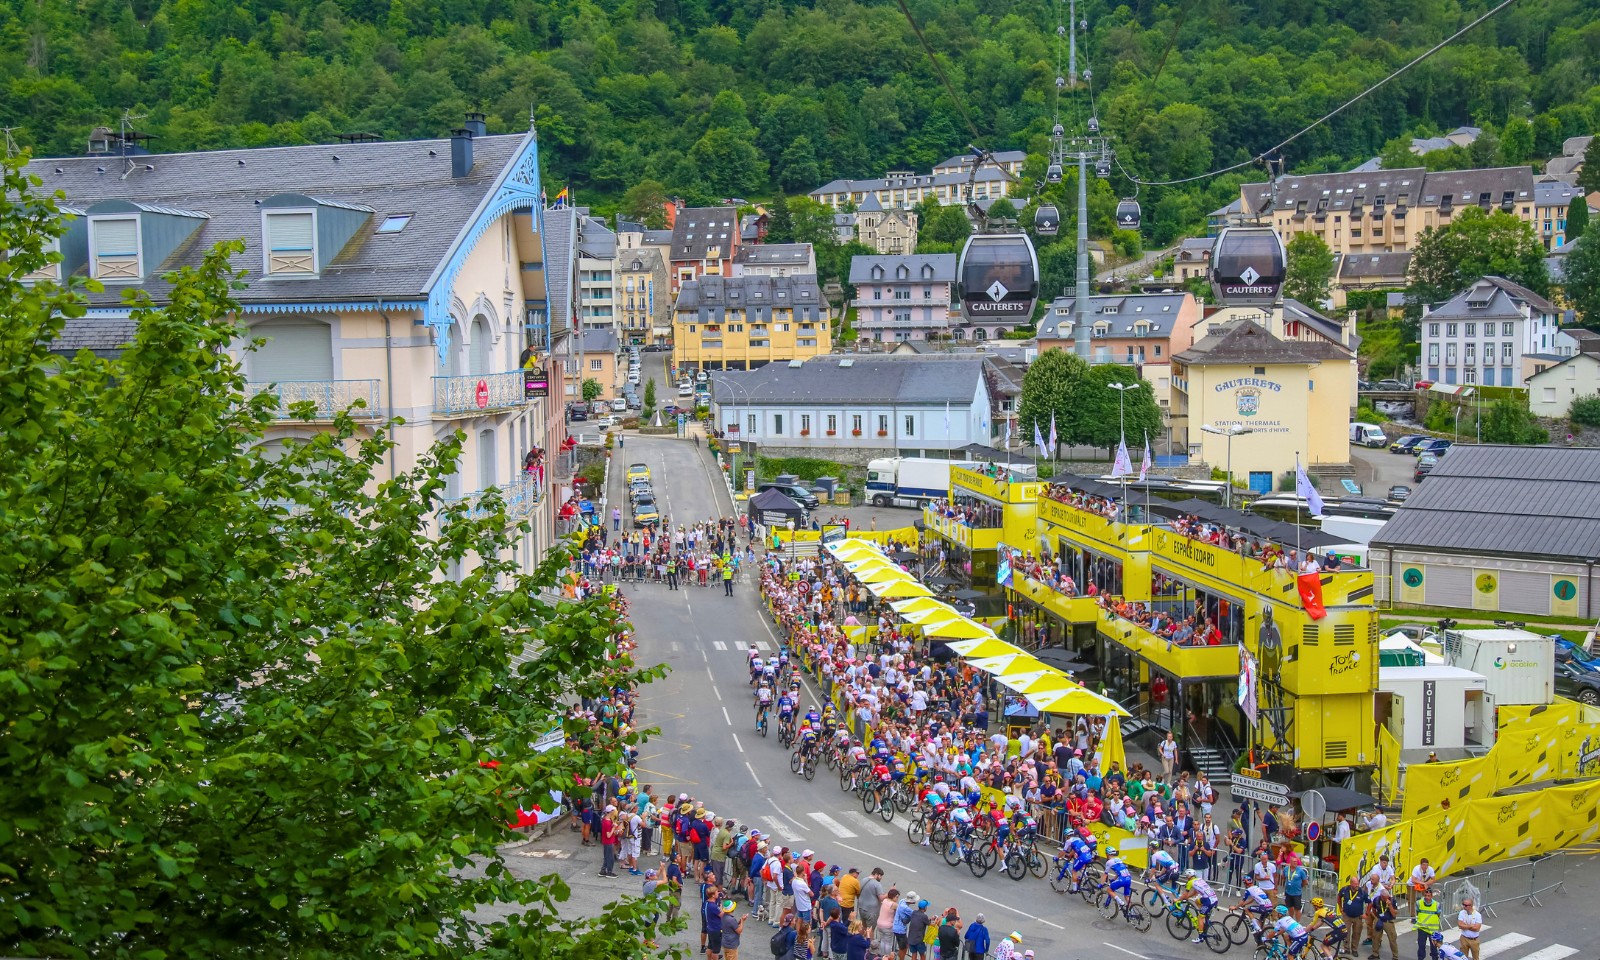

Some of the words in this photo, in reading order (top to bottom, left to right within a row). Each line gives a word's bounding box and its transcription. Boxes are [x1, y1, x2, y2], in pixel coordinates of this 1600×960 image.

[1226, 286, 1273, 294] CAUTERETS
[972, 303, 1024, 311] CAUTERETS
[1173, 541, 1193, 559] ESPACE
